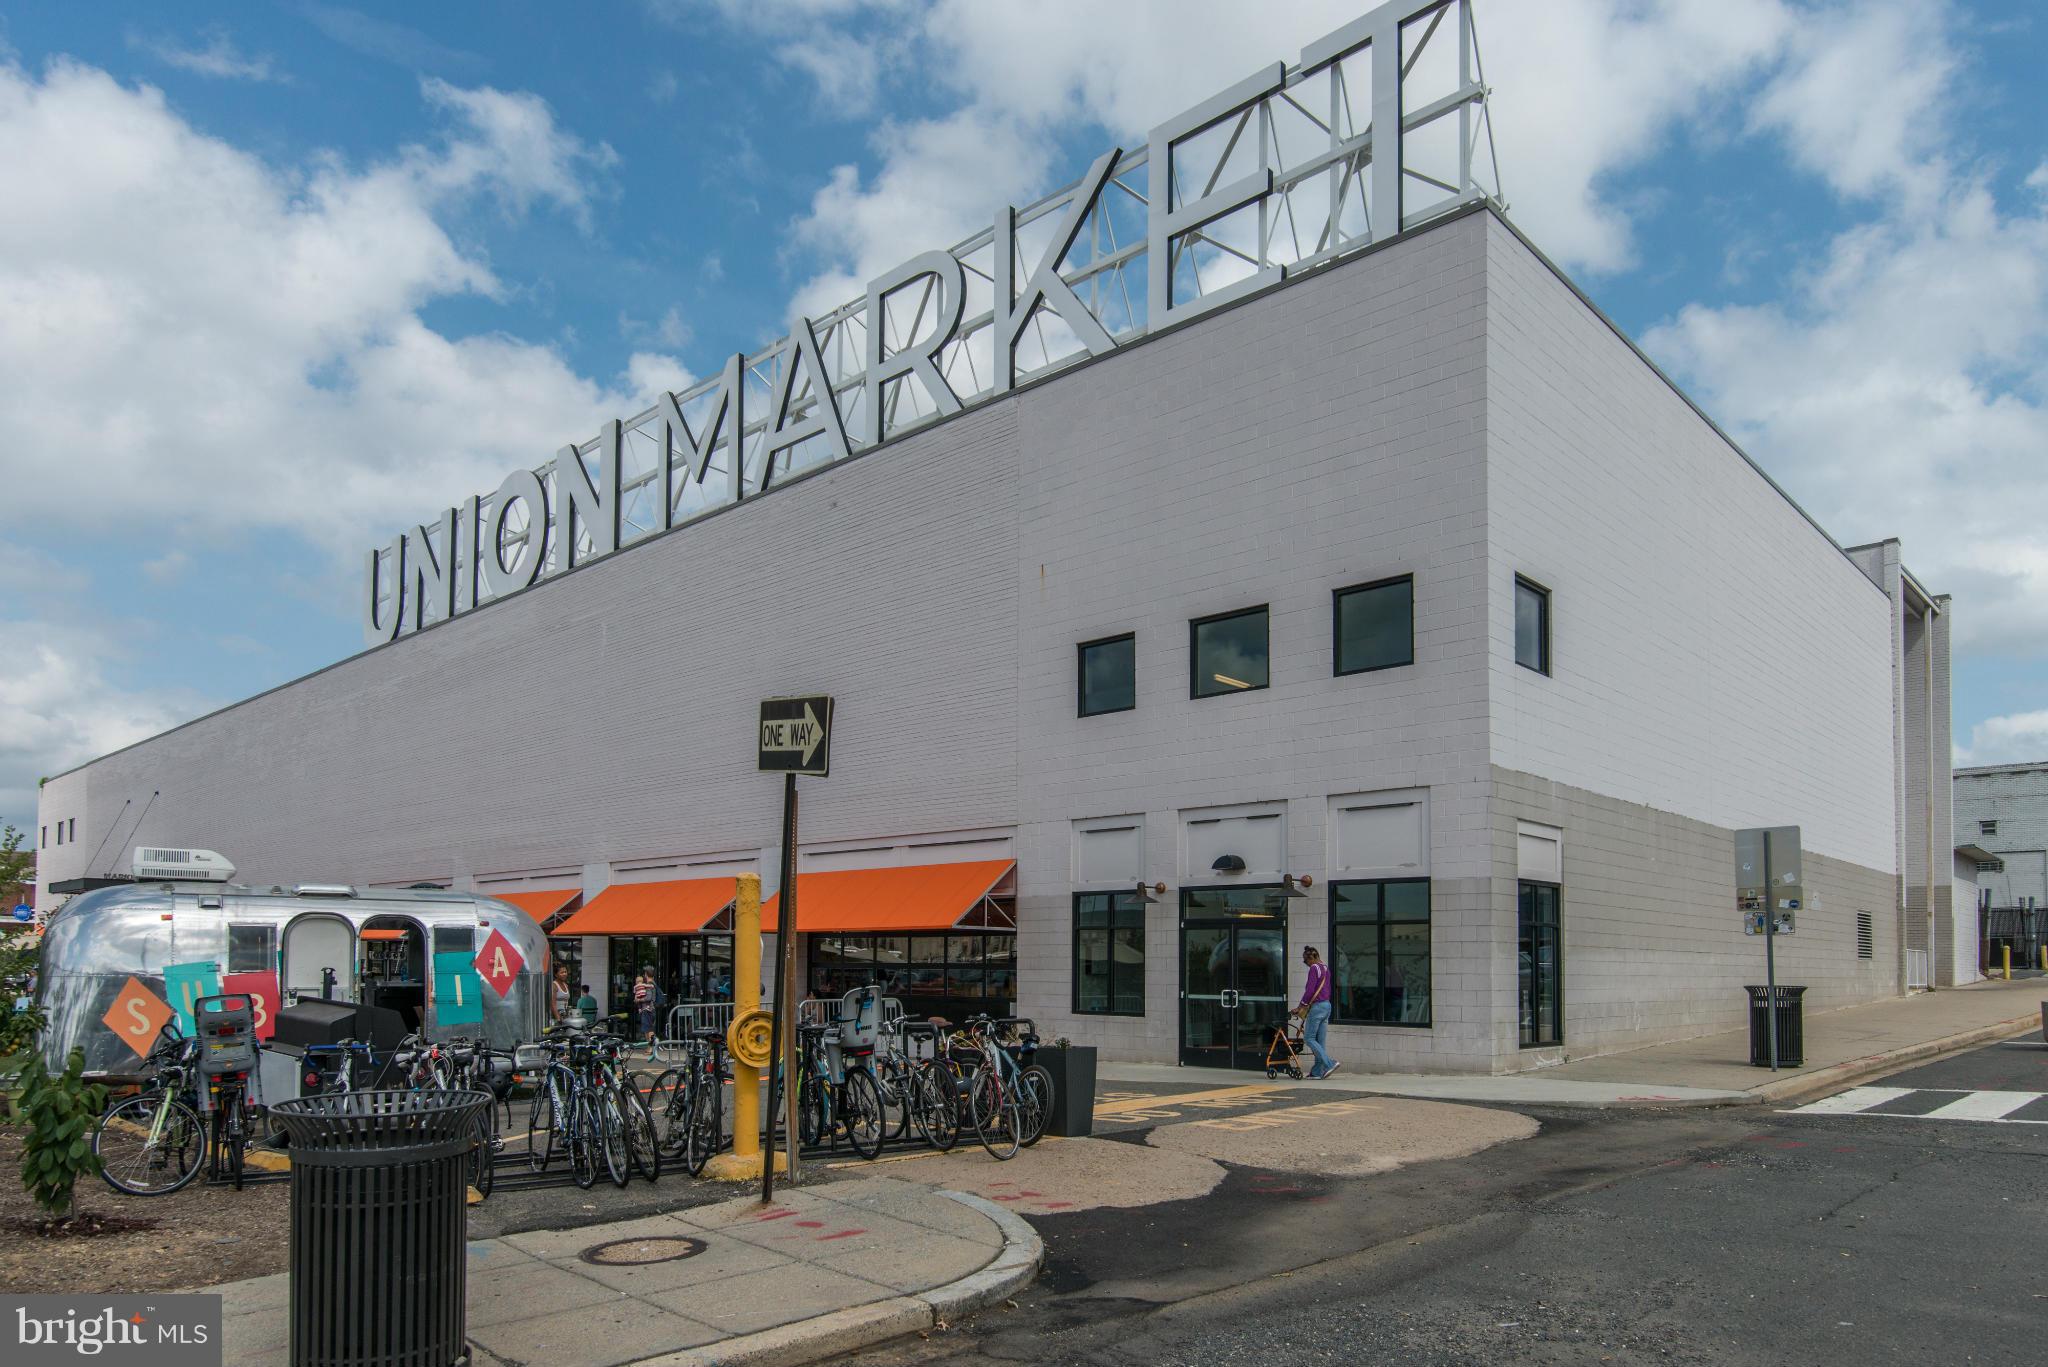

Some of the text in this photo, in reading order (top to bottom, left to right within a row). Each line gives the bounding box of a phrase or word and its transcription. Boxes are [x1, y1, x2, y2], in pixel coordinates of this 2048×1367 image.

[365, 0, 1459, 647] UNION MARKET
[763, 722, 815, 747] ONE WAY
[1192, 1102, 1384, 1132] ENTER
